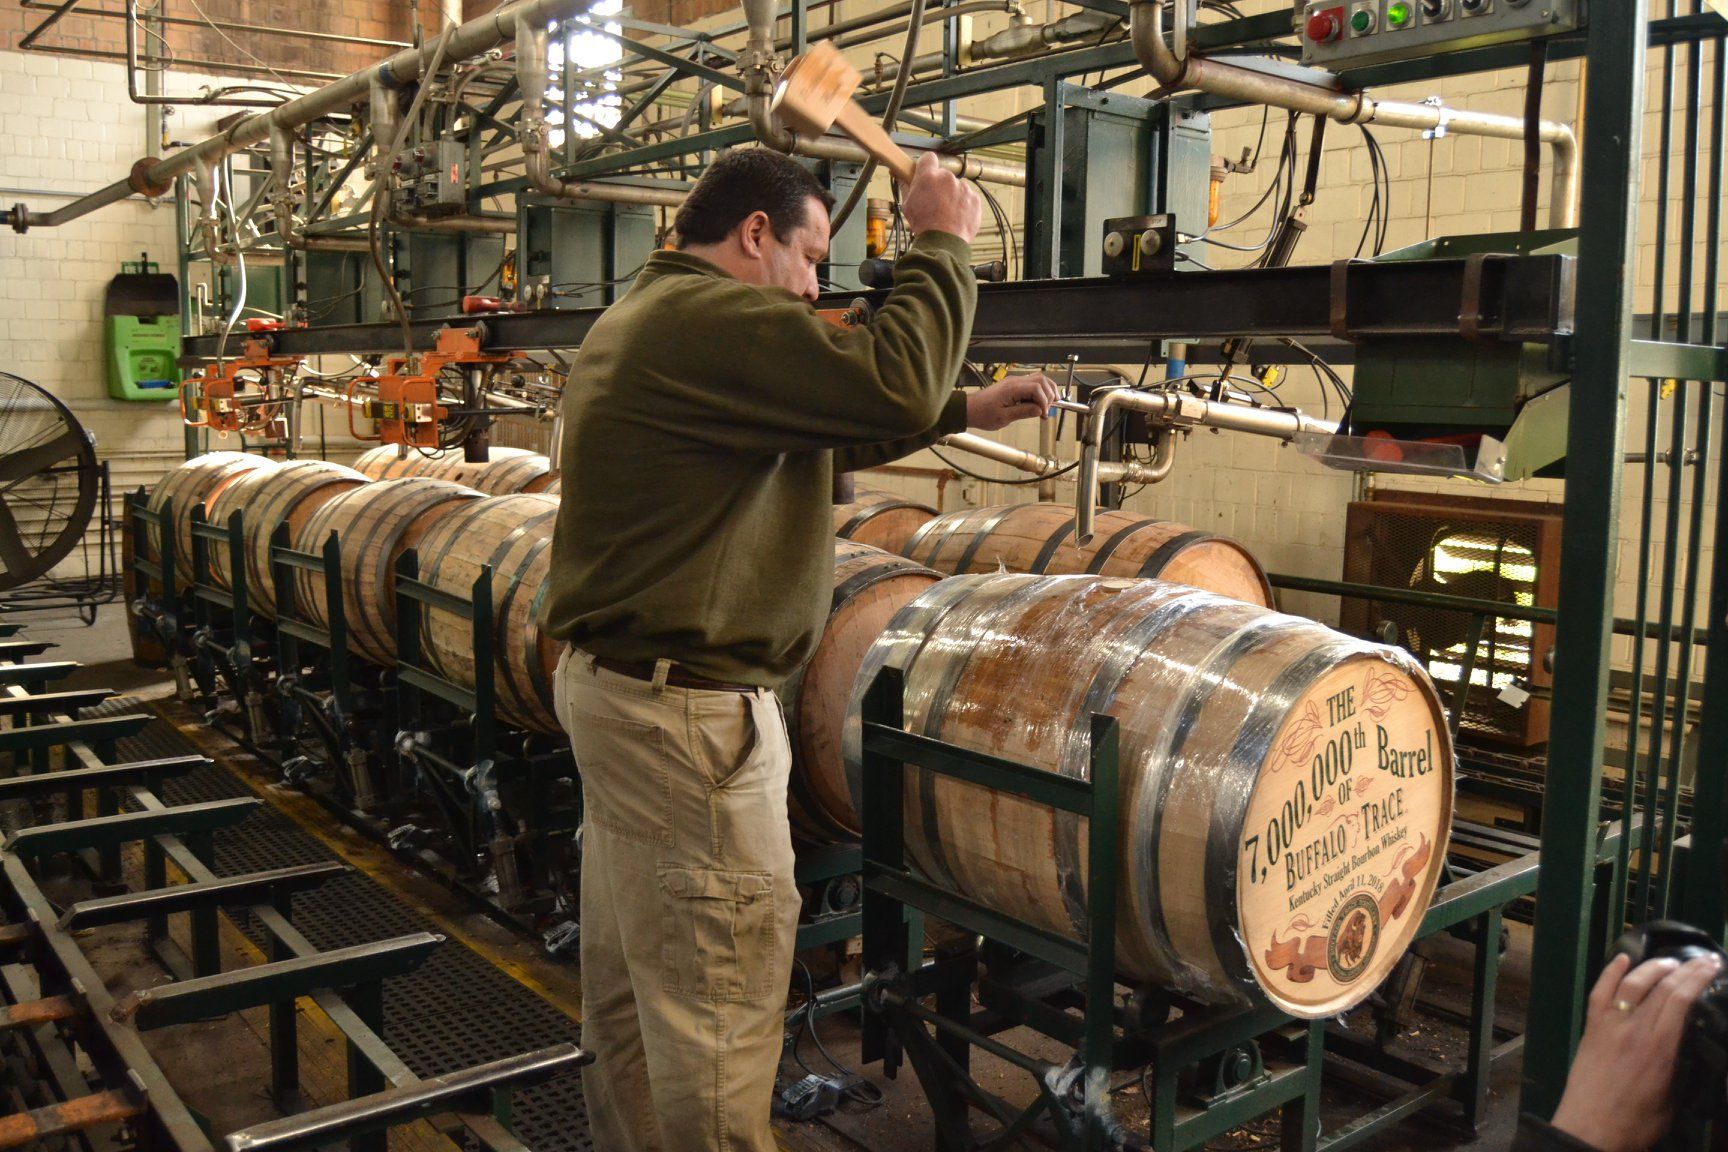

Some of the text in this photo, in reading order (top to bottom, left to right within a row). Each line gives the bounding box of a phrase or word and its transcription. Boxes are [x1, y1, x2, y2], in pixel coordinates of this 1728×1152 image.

[1326, 685, 1356, 728] THE
[1245, 721, 1433, 885] 7,000,000th Barrel
[1338, 778, 1352, 805] OF
[1285, 788, 1404, 891] BUFFALO TRACE
[1288, 826, 1408, 912] Kentucky Straight Bourbon Whiskey
[1322, 898, 1339, 929] Filled
[1339, 878, 1355, 900] April
[1367, 874, 1384, 893] 2018
